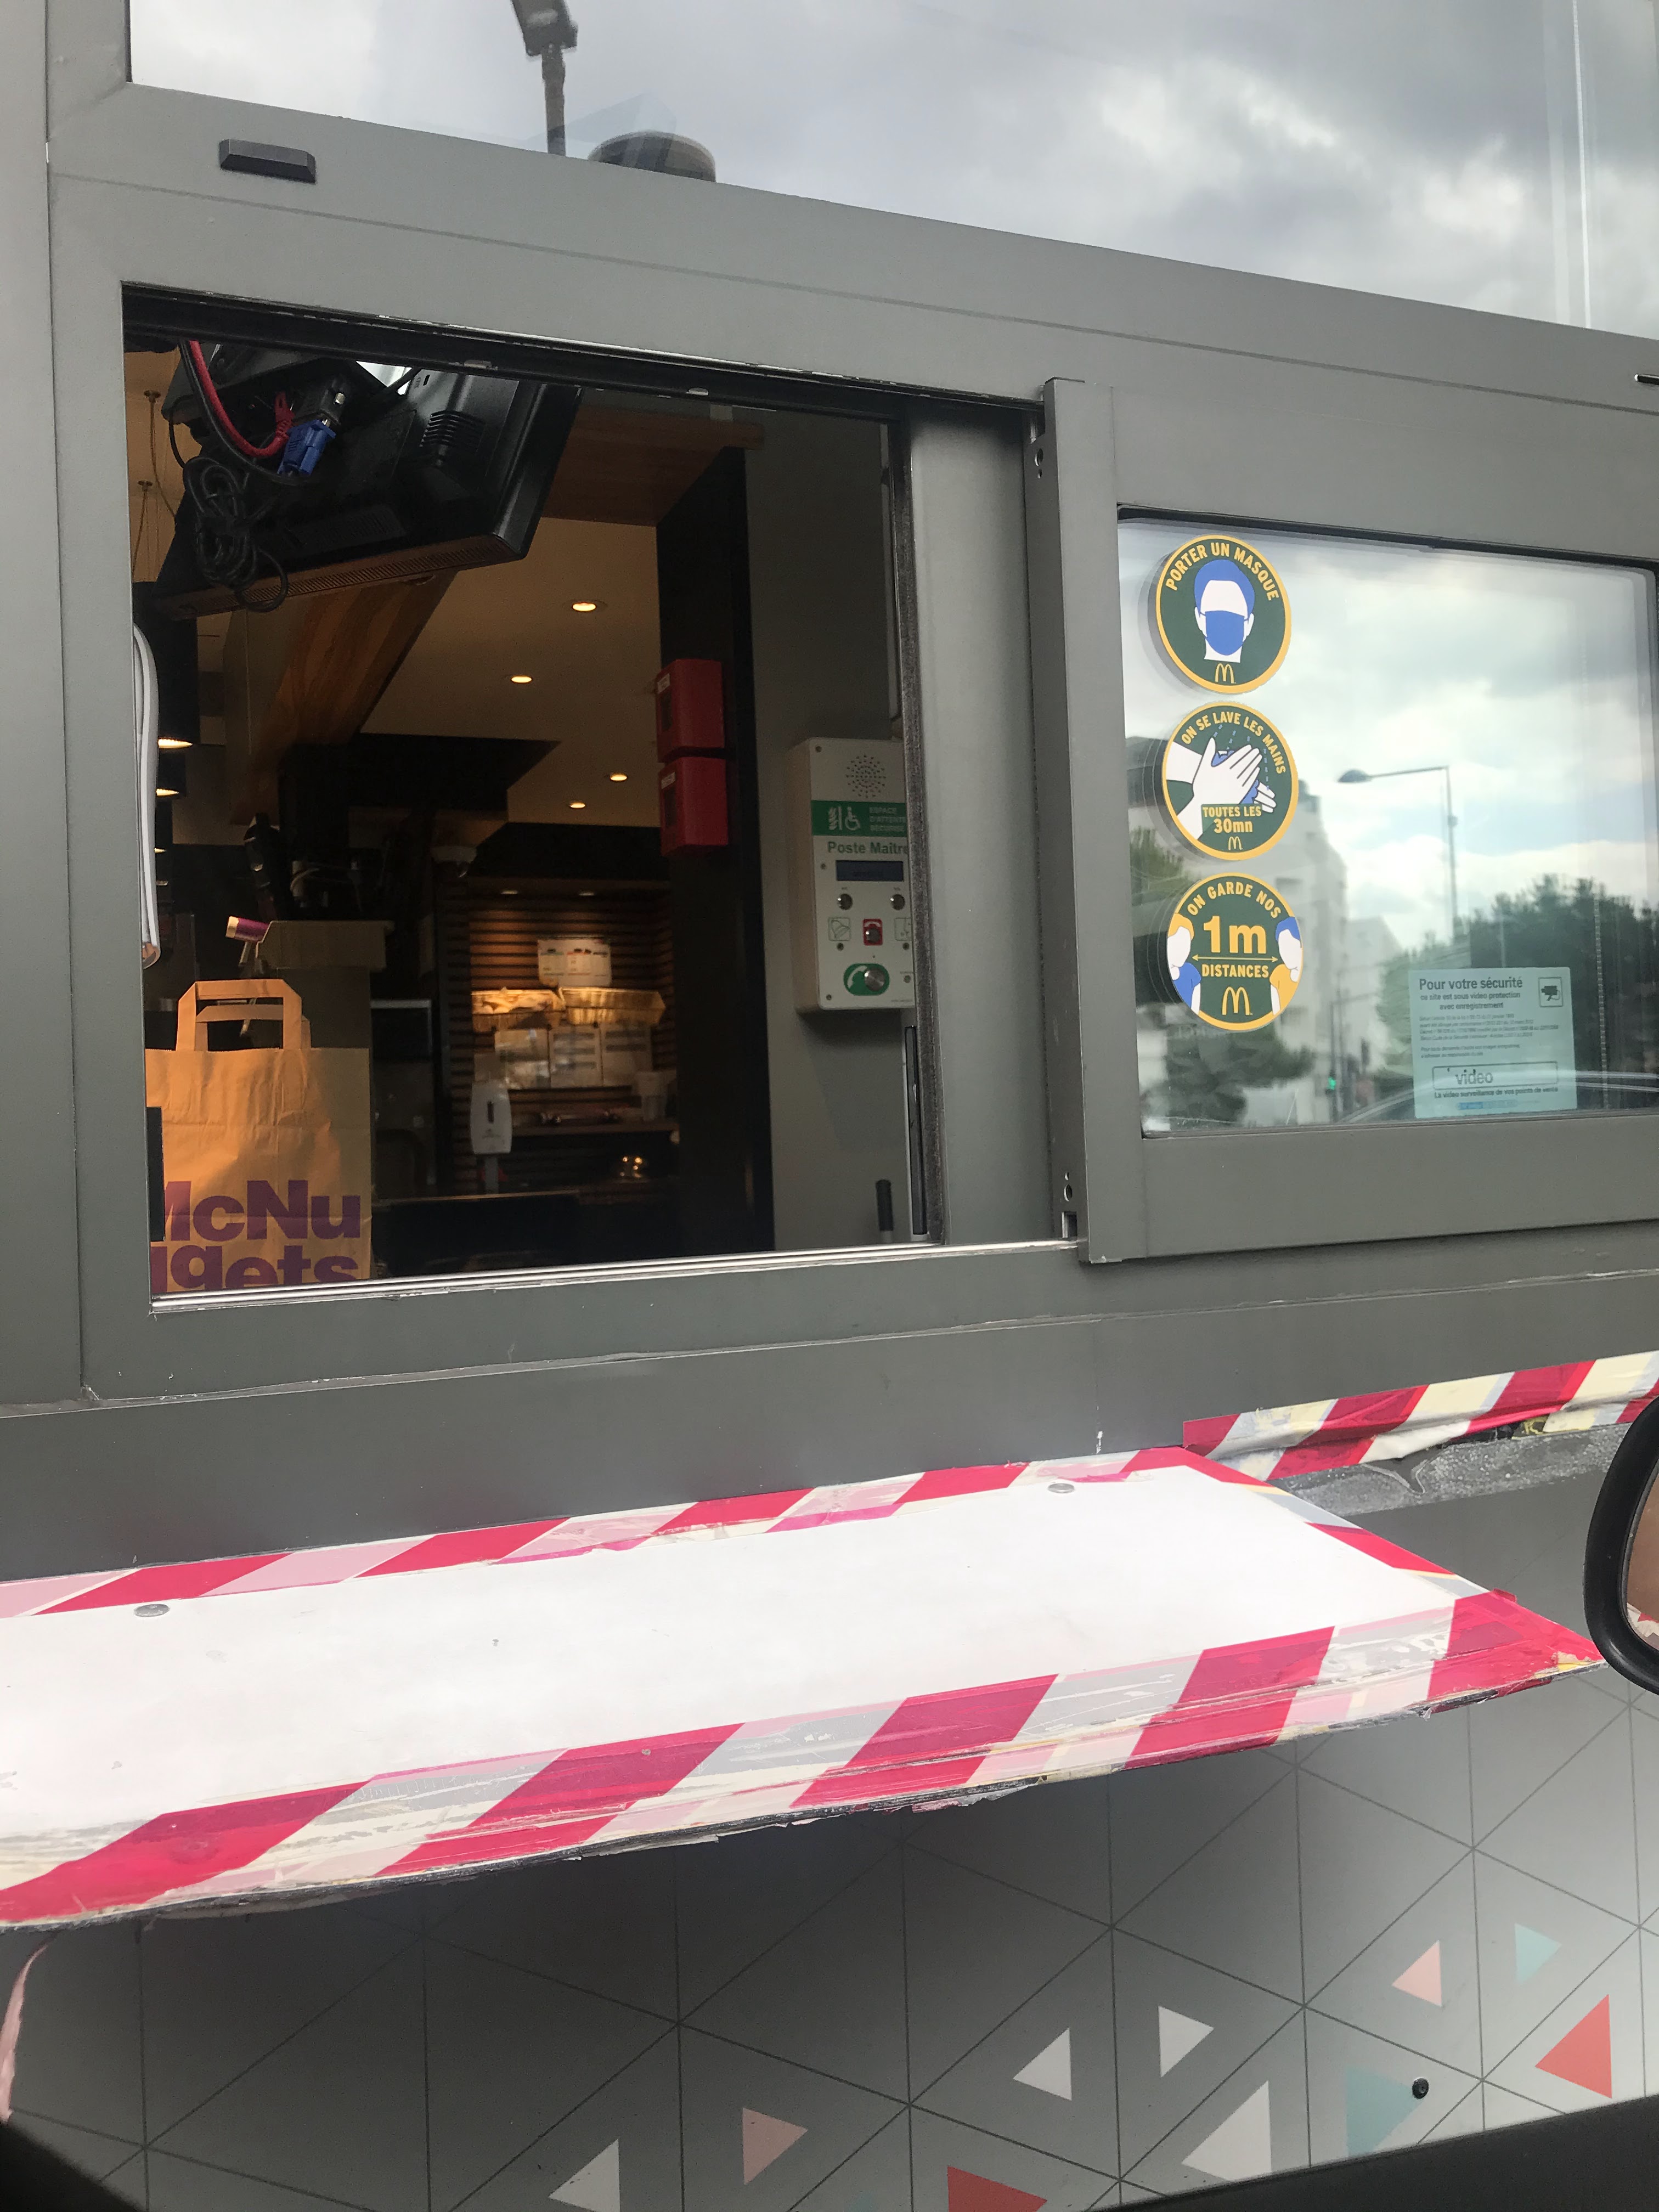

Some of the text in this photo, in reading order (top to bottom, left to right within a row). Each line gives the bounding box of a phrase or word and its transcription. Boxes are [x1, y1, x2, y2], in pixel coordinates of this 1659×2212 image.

[1165, 542, 1279, 601] PORTER UN MASQUE
[1181, 711, 1286, 774] ON SE LAVE LES MAINS
[1203, 806, 1262, 817] TOUTES LES
[1214, 819, 1253, 833] 30mn
[828, 842, 866, 854] Poste
[1187, 881, 1282, 918] ON GARDE NOS
[1203, 916, 1266, 954] 1m
[1201, 964, 1269, 978] DISTANCES
[1419, 976, 1523, 990] Pour votre sécurité
[1488, 992, 1521, 1000] protection
[1455, 1002, 1503, 1011] enregistrement
